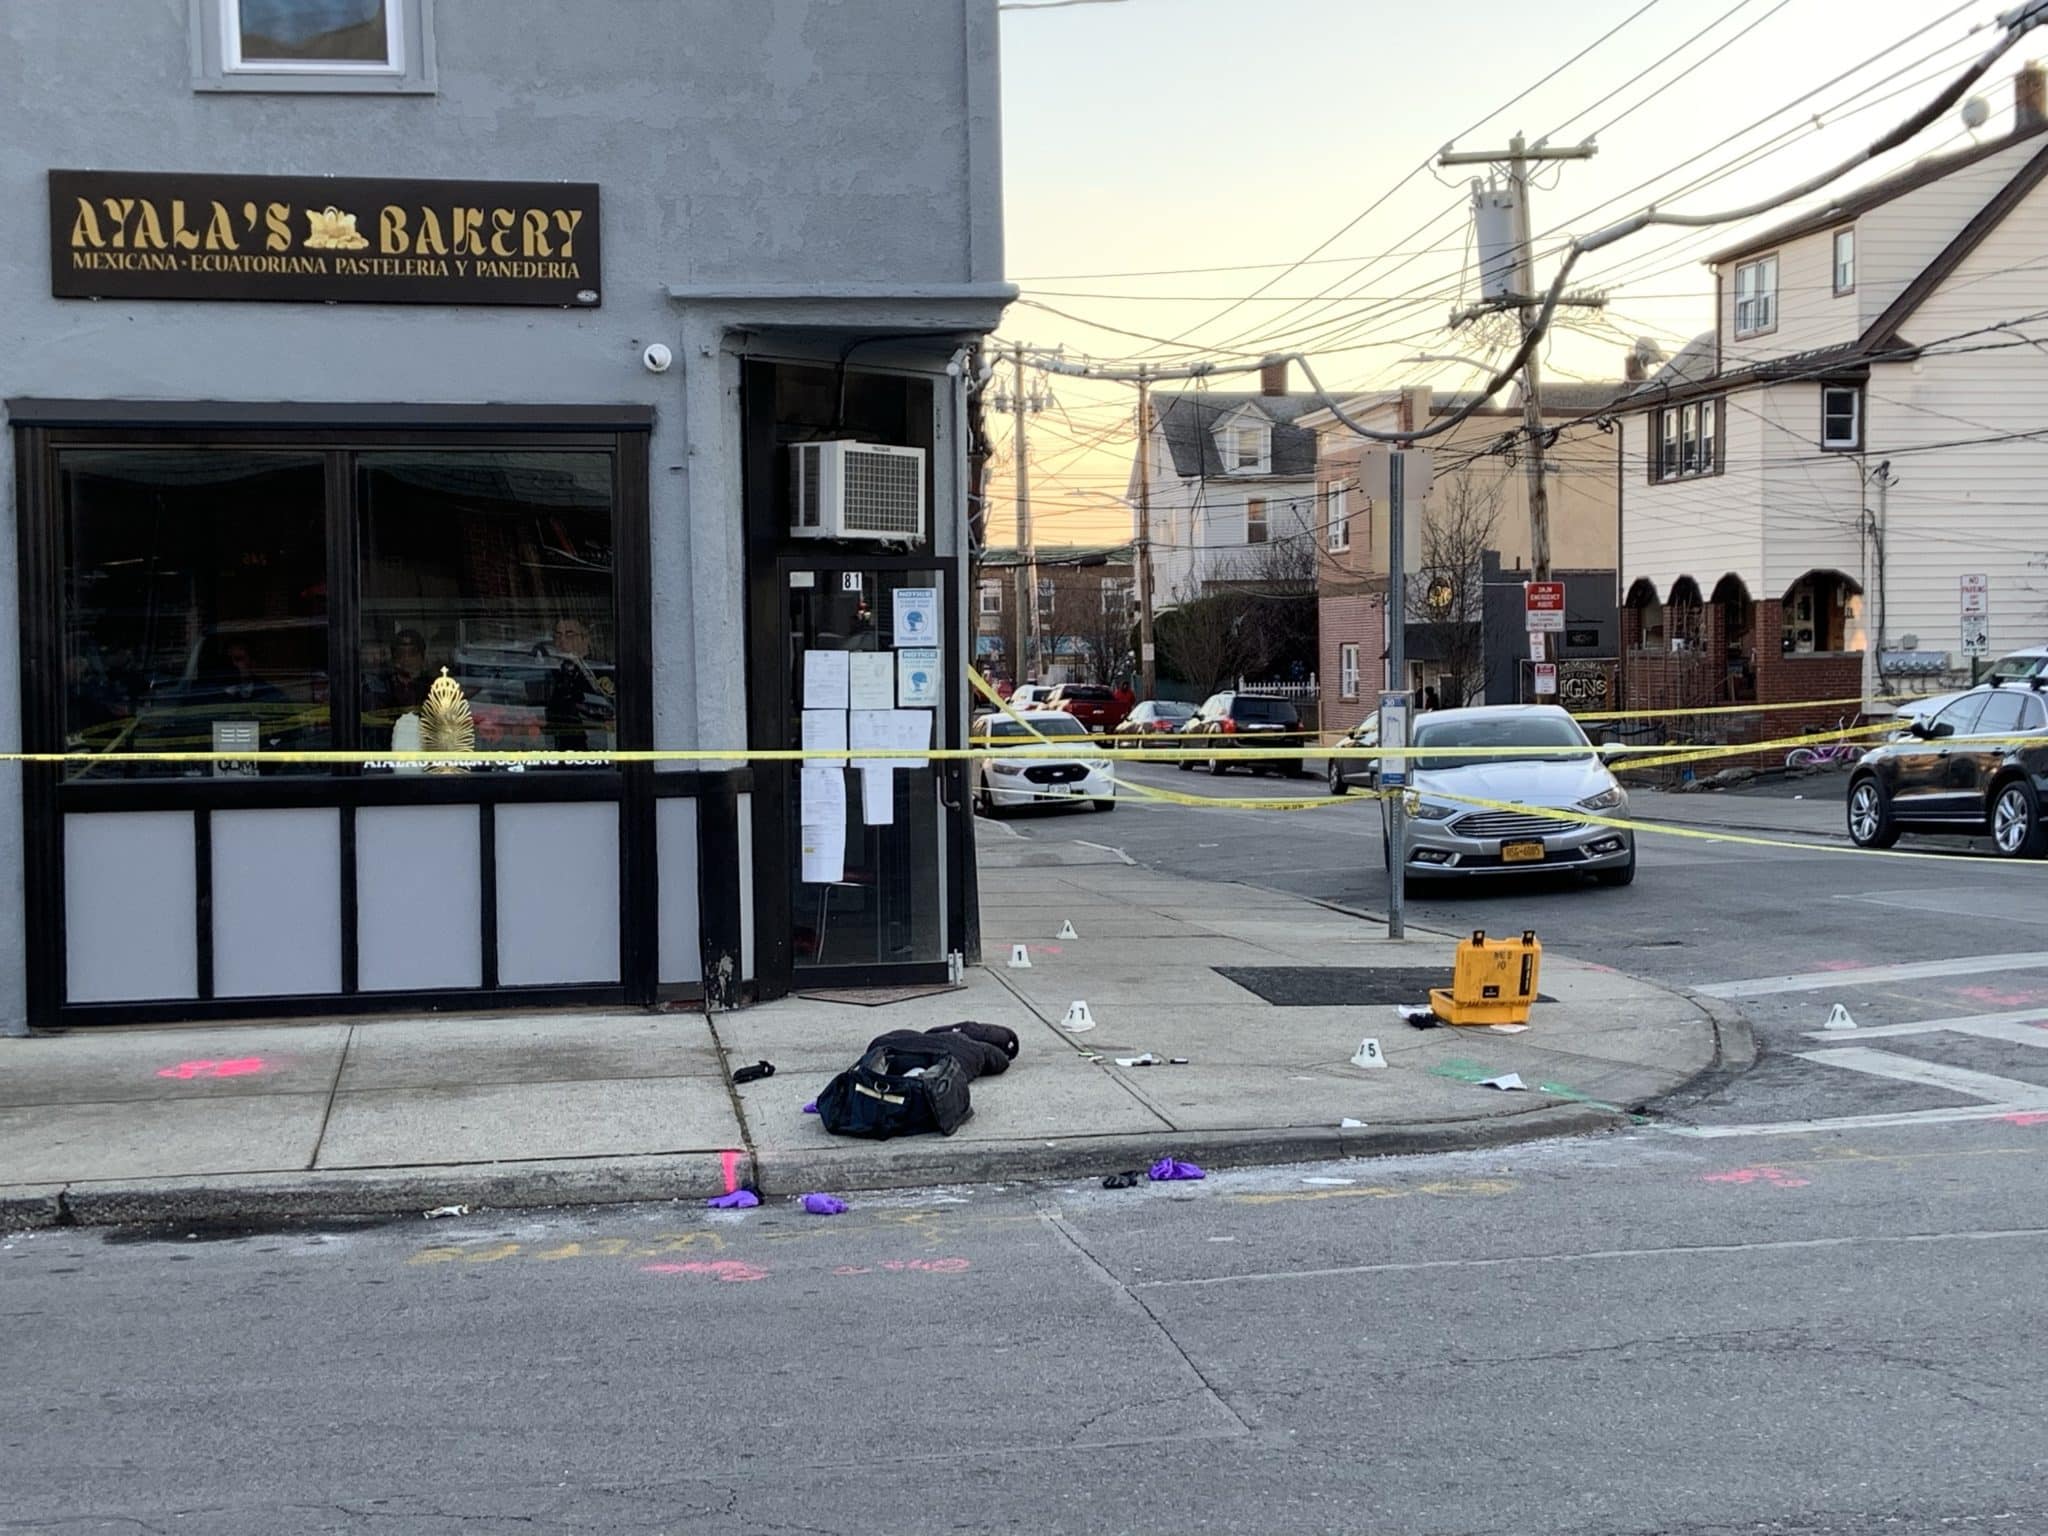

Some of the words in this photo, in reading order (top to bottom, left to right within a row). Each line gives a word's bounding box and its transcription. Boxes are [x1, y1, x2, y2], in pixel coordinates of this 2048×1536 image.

[71, 197, 292, 252] AYALA'S
[380, 205, 583, 258] BAKERY
[335, 258, 449, 276] PASTELERIA
[456, 260, 468, 277] Y
[476, 261, 581, 279] PANEDERIA
[844, 573, 860, 589] 81
[1559, 678, 1608, 698] IGNS
